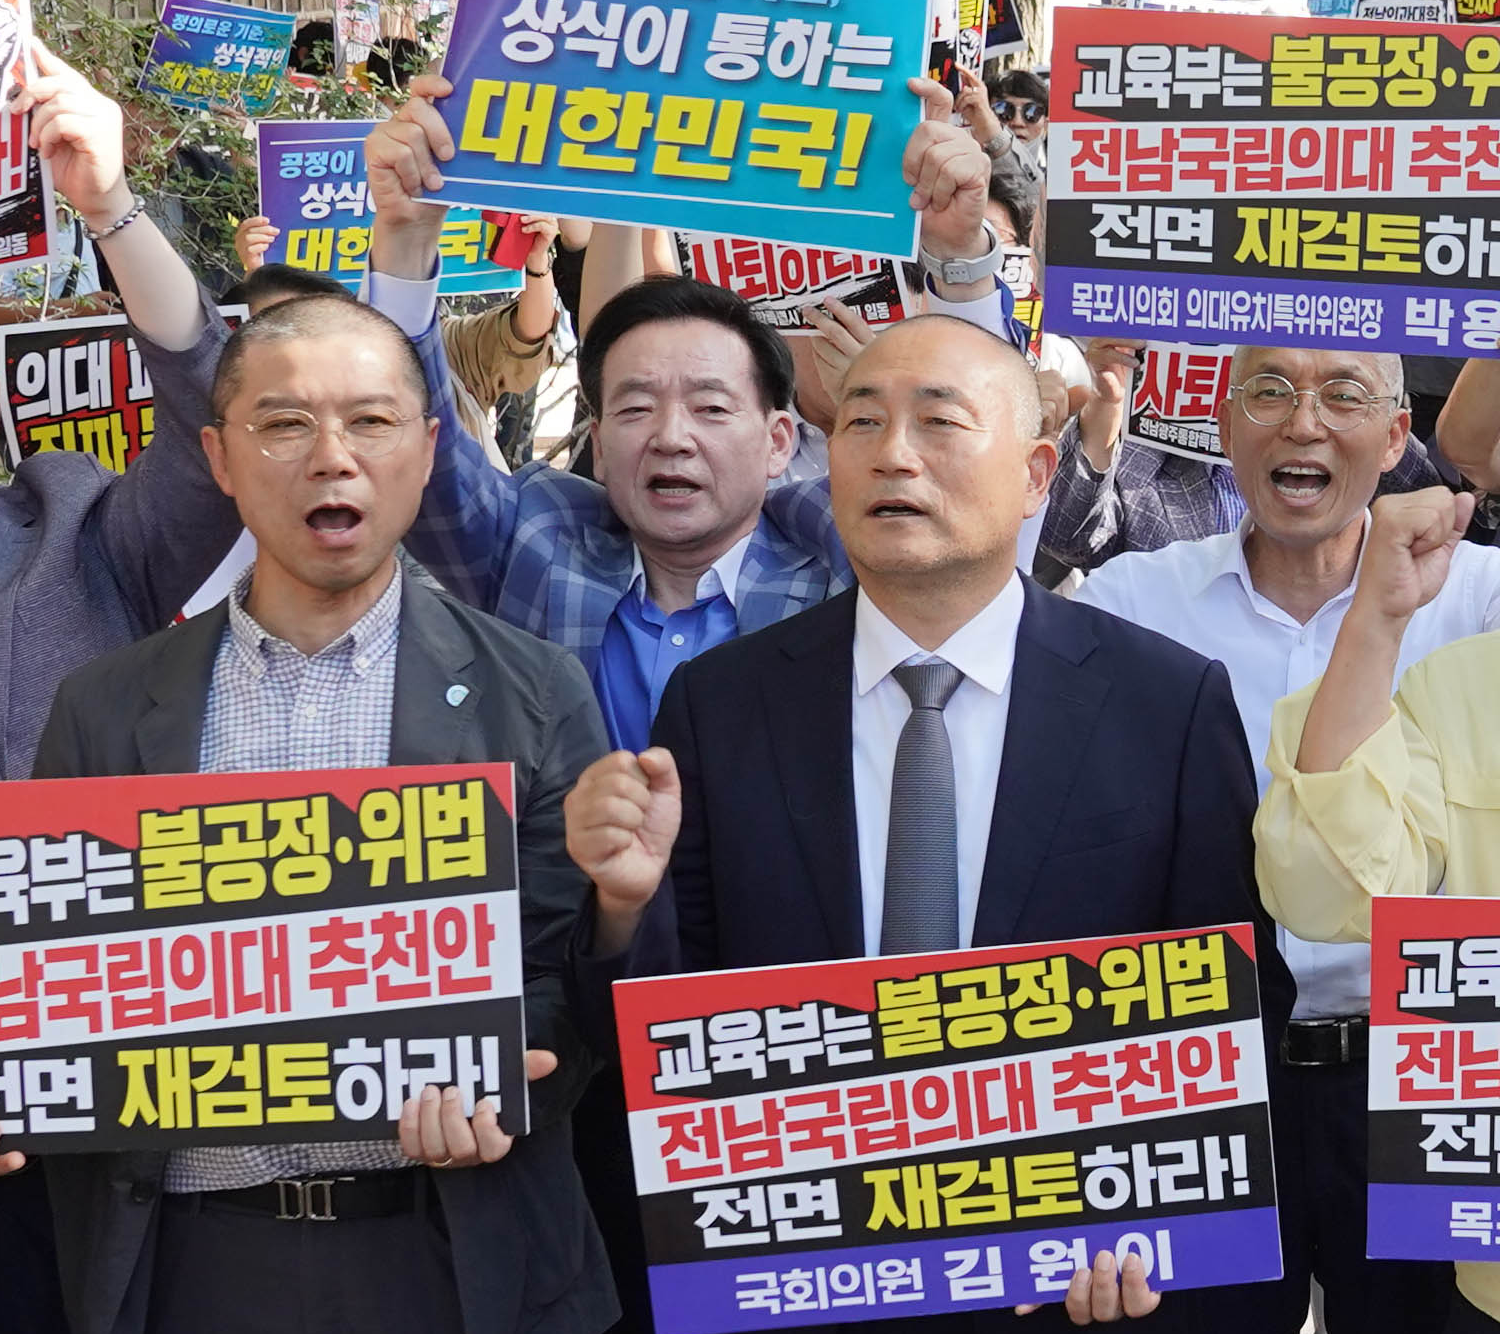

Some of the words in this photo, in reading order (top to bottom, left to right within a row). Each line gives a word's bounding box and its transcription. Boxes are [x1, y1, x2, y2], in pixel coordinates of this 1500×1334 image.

[706, 11, 893, 91] 통하는
[1073, 45, 1264, 109] 교육부는
[279, 151, 355, 178] 공정이
[460, 78, 872, 189] 대한민국!
[1070, 126, 1395, 194] 전남국립의대
[1089, 202, 1214, 264] 전면
[1072, 281, 1179, 326] 목포시의회
[1186, 287, 1384, 340] 의대유치특위위원장
[15, 340, 111, 418] 의대
[308, 903, 496, 1008] 추천안
[647, 1002, 873, 1093] 교육부는
[657, 1061, 1036, 1183] 전남국립의대
[1052, 1031, 1240, 1123] 추천안
[693, 1178, 842, 1248] 전면
[863, 1135, 1250, 1233] 재검토하라!
[734, 1258, 924, 1316] 국회의원
